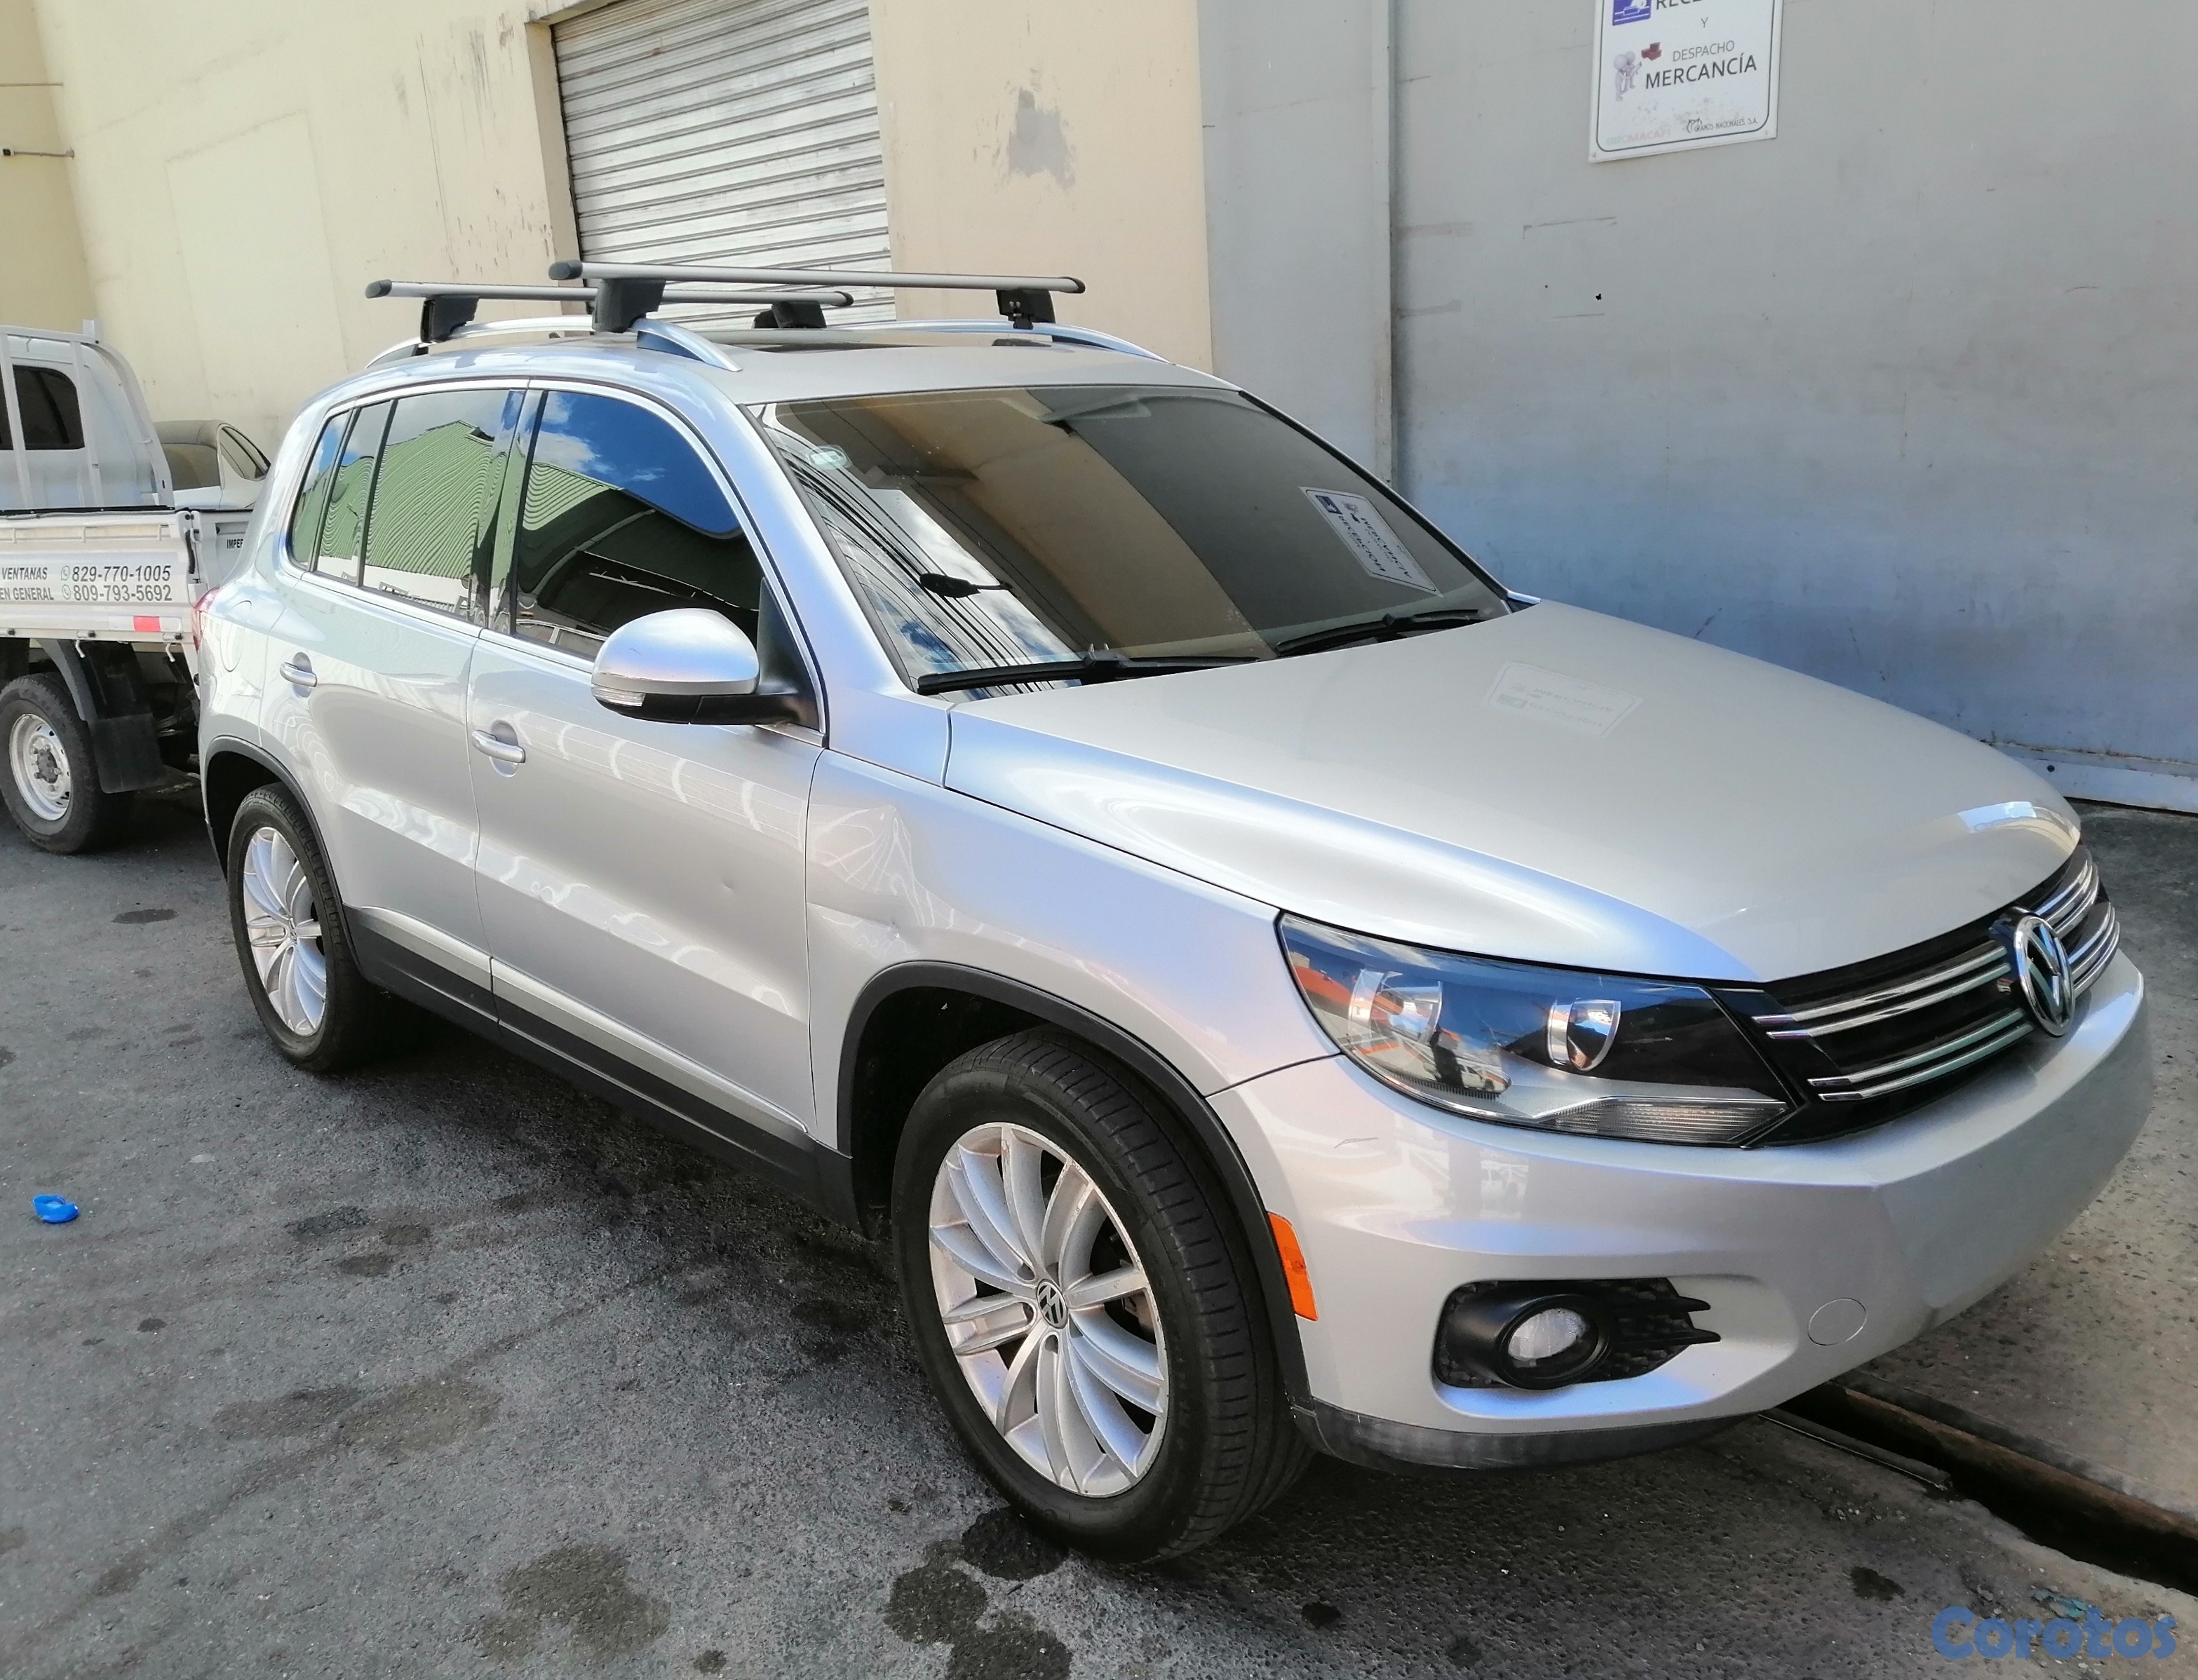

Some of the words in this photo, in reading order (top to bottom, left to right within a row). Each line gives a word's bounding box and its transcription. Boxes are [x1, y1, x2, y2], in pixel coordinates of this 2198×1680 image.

[1700, 17, 1709, 29] Y
[1672, 40, 1736, 62] DESPACHO
[1645, 52, 1758, 89] MERCANCÍA
[1, 567, 48, 581] VENTANAS
[72, 565, 171, 582] 829-770-1005
[0, 588, 11, 600] EN
[13, 588, 55, 601] GENERAL
[73, 584, 173, 601] 809-793-5692
